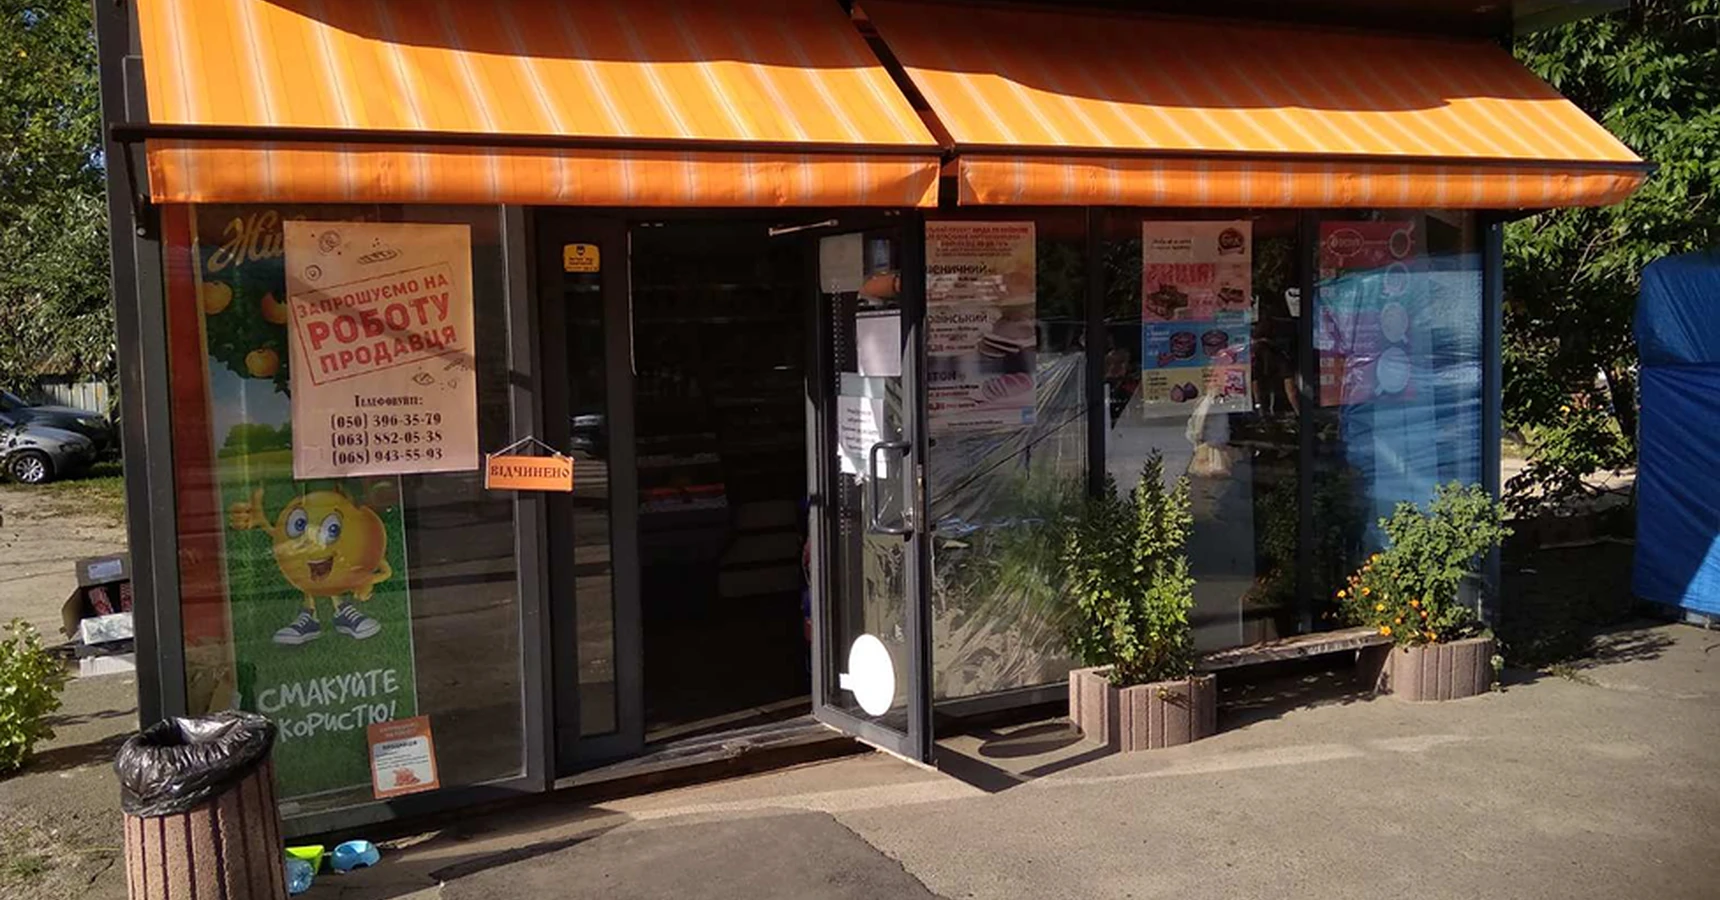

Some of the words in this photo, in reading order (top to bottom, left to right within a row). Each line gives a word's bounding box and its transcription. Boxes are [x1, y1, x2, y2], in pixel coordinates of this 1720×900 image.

[297, 281, 420, 319] ЗАПРОШУЄМО
[424, 273, 449, 291] НА
[307, 292, 450, 350] РОБОТУ
[320, 325, 457, 374] ПРОДАВЦЯ
[330, 413, 368, 431] (050)
[331, 431, 369, 449] (063)
[374, 430, 442, 446] 882-05-38
[332, 448, 370, 467] (068)
[375, 448, 443, 463] 943-55-93
[490, 465, 570, 478] ВІДЧИНЕНО
[257, 669, 400, 713] СМАКУЙТЕ
[277, 700, 397, 743] КОРИСТЮ!
